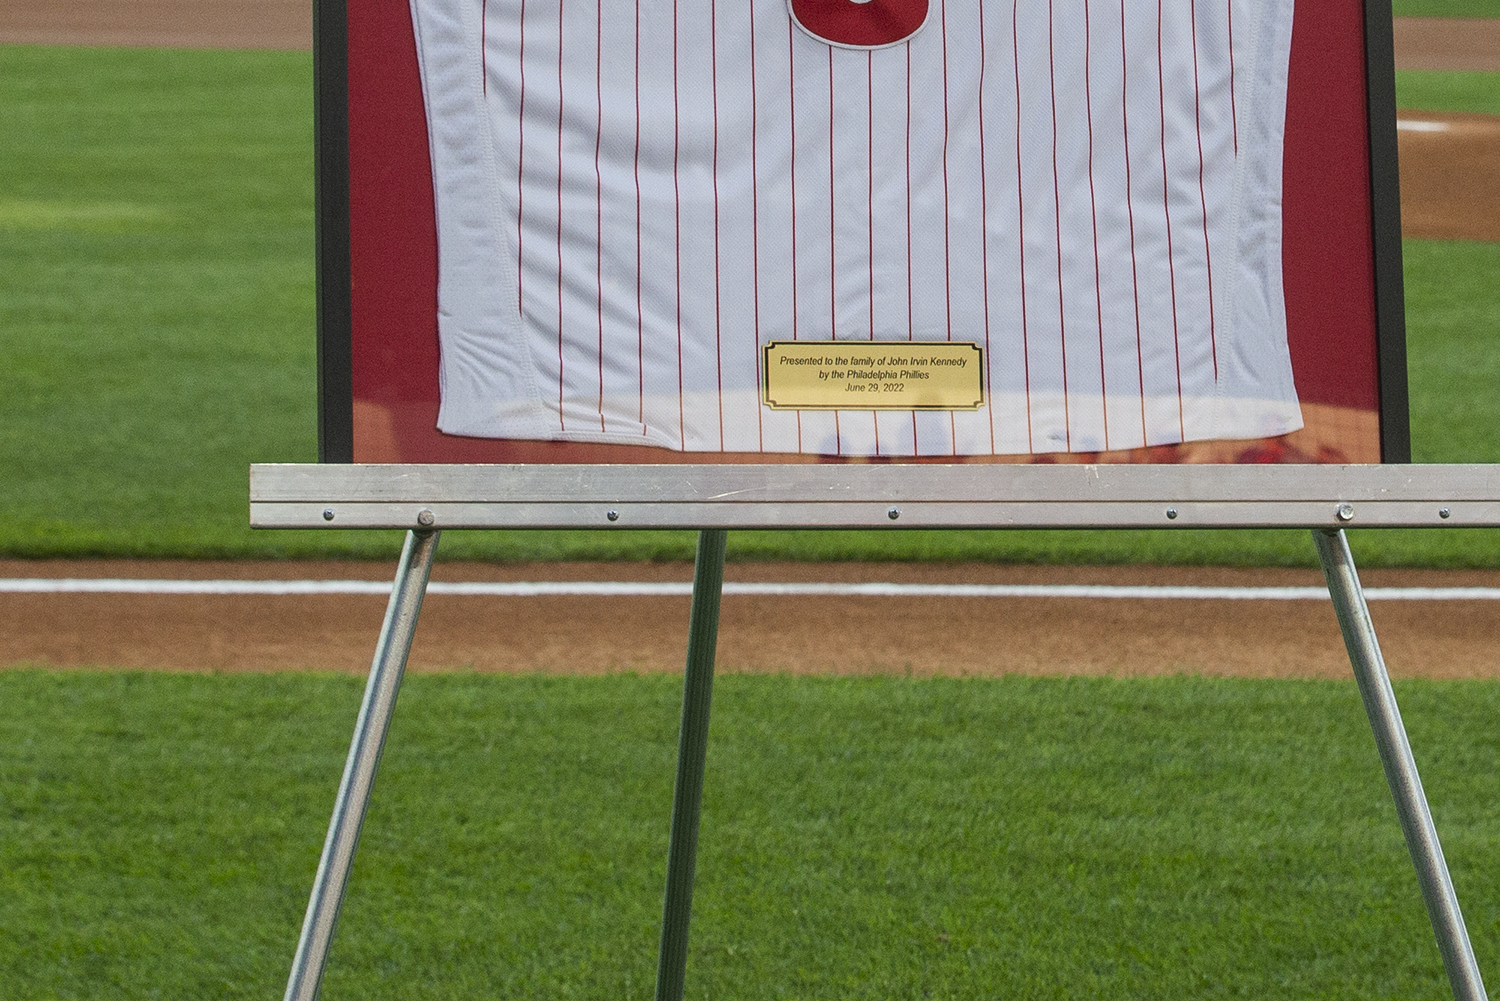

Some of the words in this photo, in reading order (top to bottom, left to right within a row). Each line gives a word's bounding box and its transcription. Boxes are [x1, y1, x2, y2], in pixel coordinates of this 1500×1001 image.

[779, 356, 823, 366] Presented
[824, 356, 834, 366] to
[835, 356, 849, 366] the
[850, 356, 875, 368] family
[877, 356, 886, 366] of
[886, 356, 908, 366] John
[910, 356, 928, 366] Irvin
[930, 356, 968, 368] Kennedy
[818, 370, 830, 380] by
[831, 370, 845, 379] the
[846, 370, 898, 381] Philadelphia
[899, 370, 930, 380] Phillies
[844, 383, 866, 392] June
[868, 383, 881, 394] 29,
[883, 383, 905, 393] 2022
